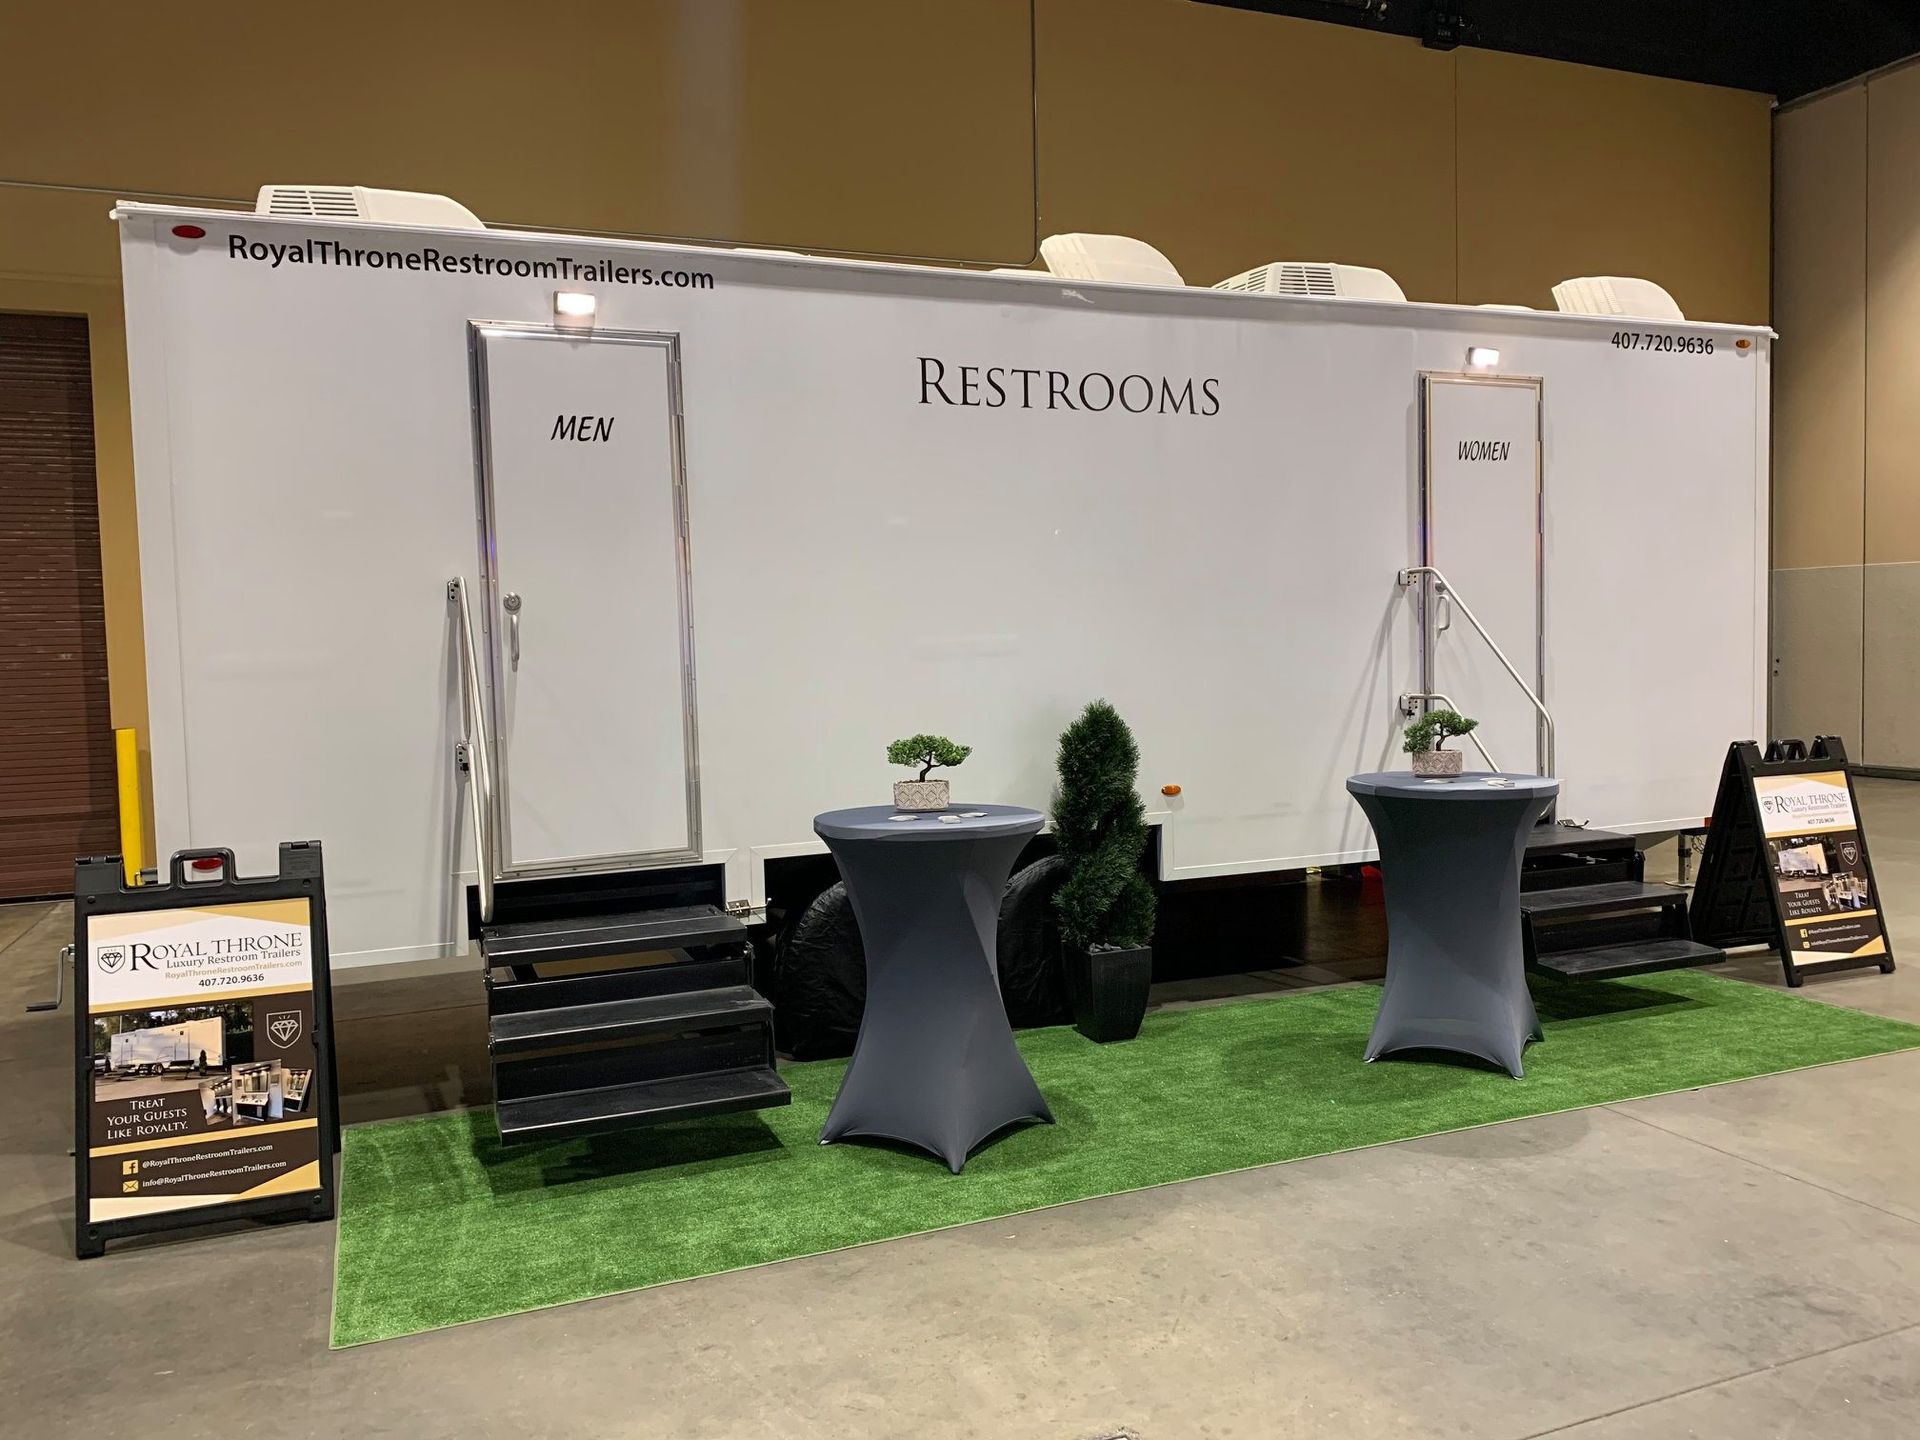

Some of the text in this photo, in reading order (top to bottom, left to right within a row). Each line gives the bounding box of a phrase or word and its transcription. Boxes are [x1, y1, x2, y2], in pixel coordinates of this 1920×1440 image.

[228, 234, 714, 290] RoyalThroneRestroomTrailers.com
[1611, 331, 1714, 355] 407.720.9636
[916, 356, 1220, 416] RESTROOMS
[550, 414, 615, 442] MEN
[1457, 440, 1511, 461] WOMEN
[1774, 792, 1847, 813] ROYAL THRONE
[129, 932, 303, 972] ROYAL THRONE
[166, 948, 301, 970] Luxury Restroom Trailers
[165, 960, 303, 980] RoyalThroneRestroomTrailers.com
[198, 973, 265, 987] 407.720.9636
[129, 1097, 166, 1111] TREAT
[107, 1107, 188, 1127] YOUR GUESTS
[107, 1120, 189, 1140] LIKE ROYALTY.
[142, 1144, 273, 1169] @RoyalThroneRestroomTrailers.com
[142, 1160, 287, 1188] info@RoyalThroneRestroomTrailers.com
